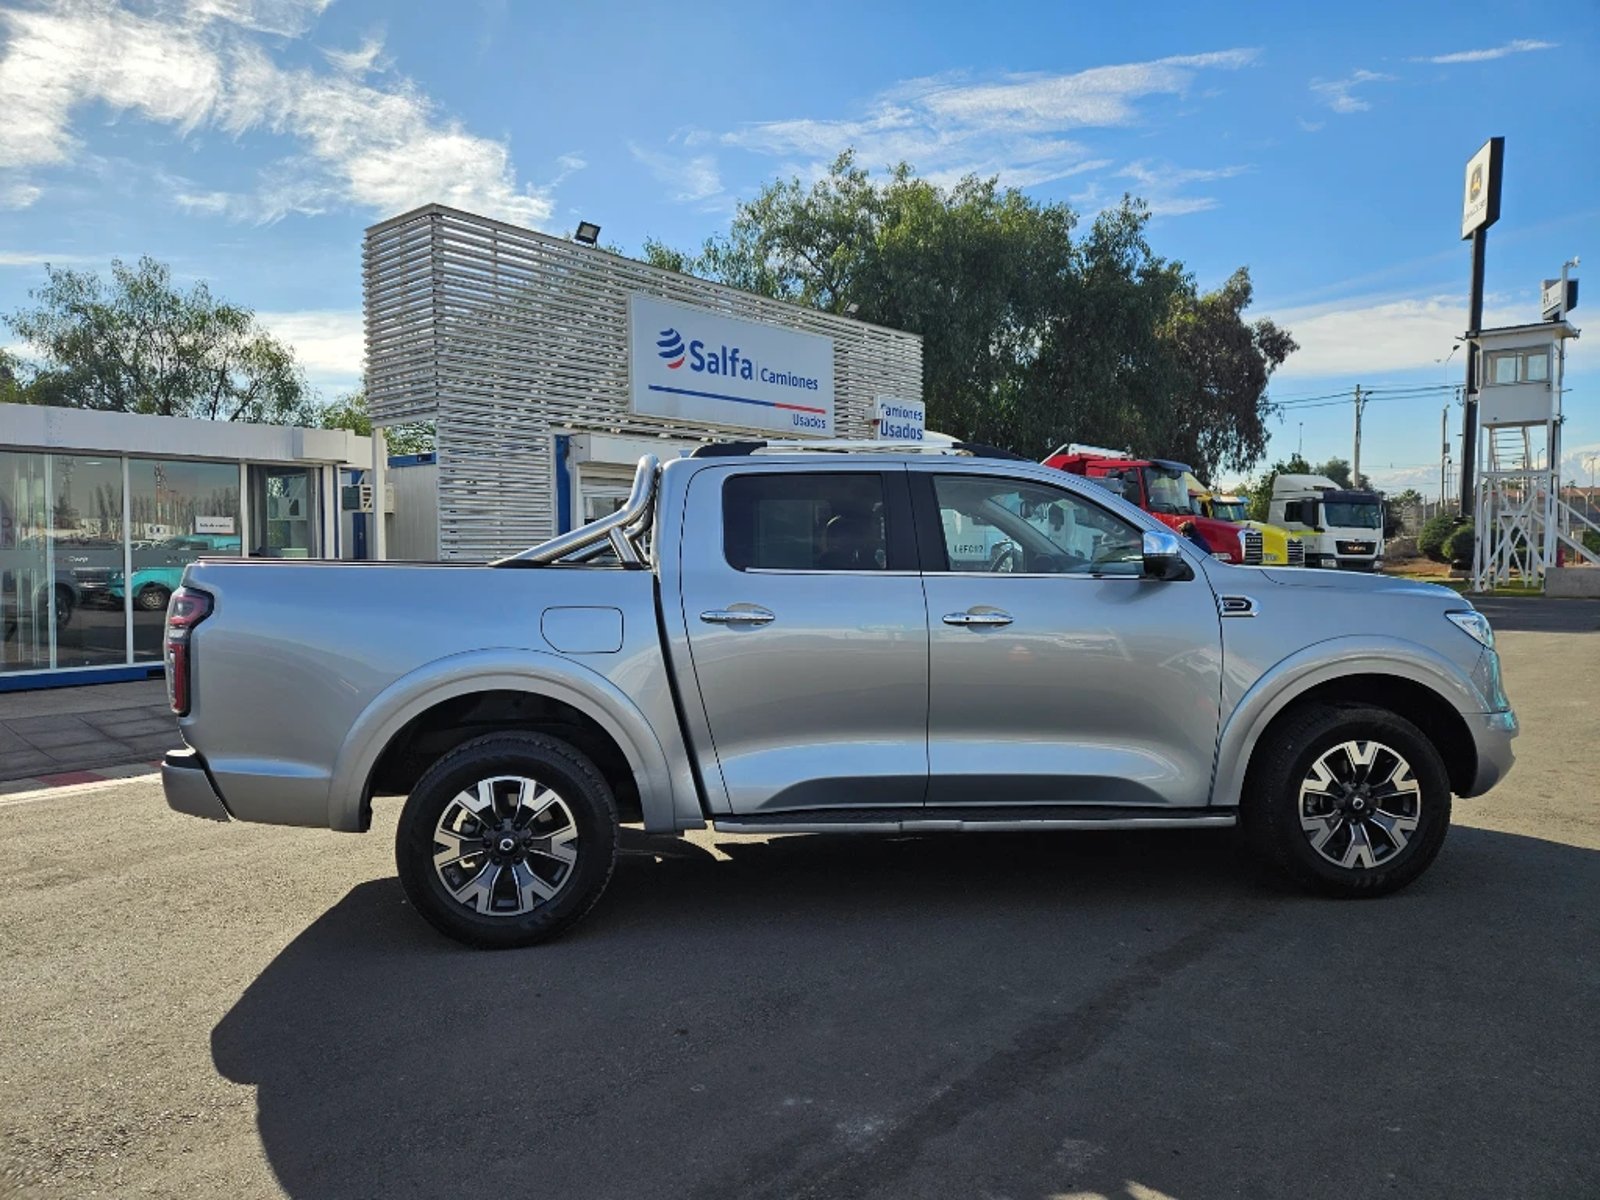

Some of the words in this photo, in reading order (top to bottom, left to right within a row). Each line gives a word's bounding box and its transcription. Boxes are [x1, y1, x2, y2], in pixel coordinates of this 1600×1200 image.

[690, 340, 752, 380] Salfa
[761, 368, 818, 390] Camiones
[793, 413, 826, 429] Usados
[880, 420, 923, 442] Usados
